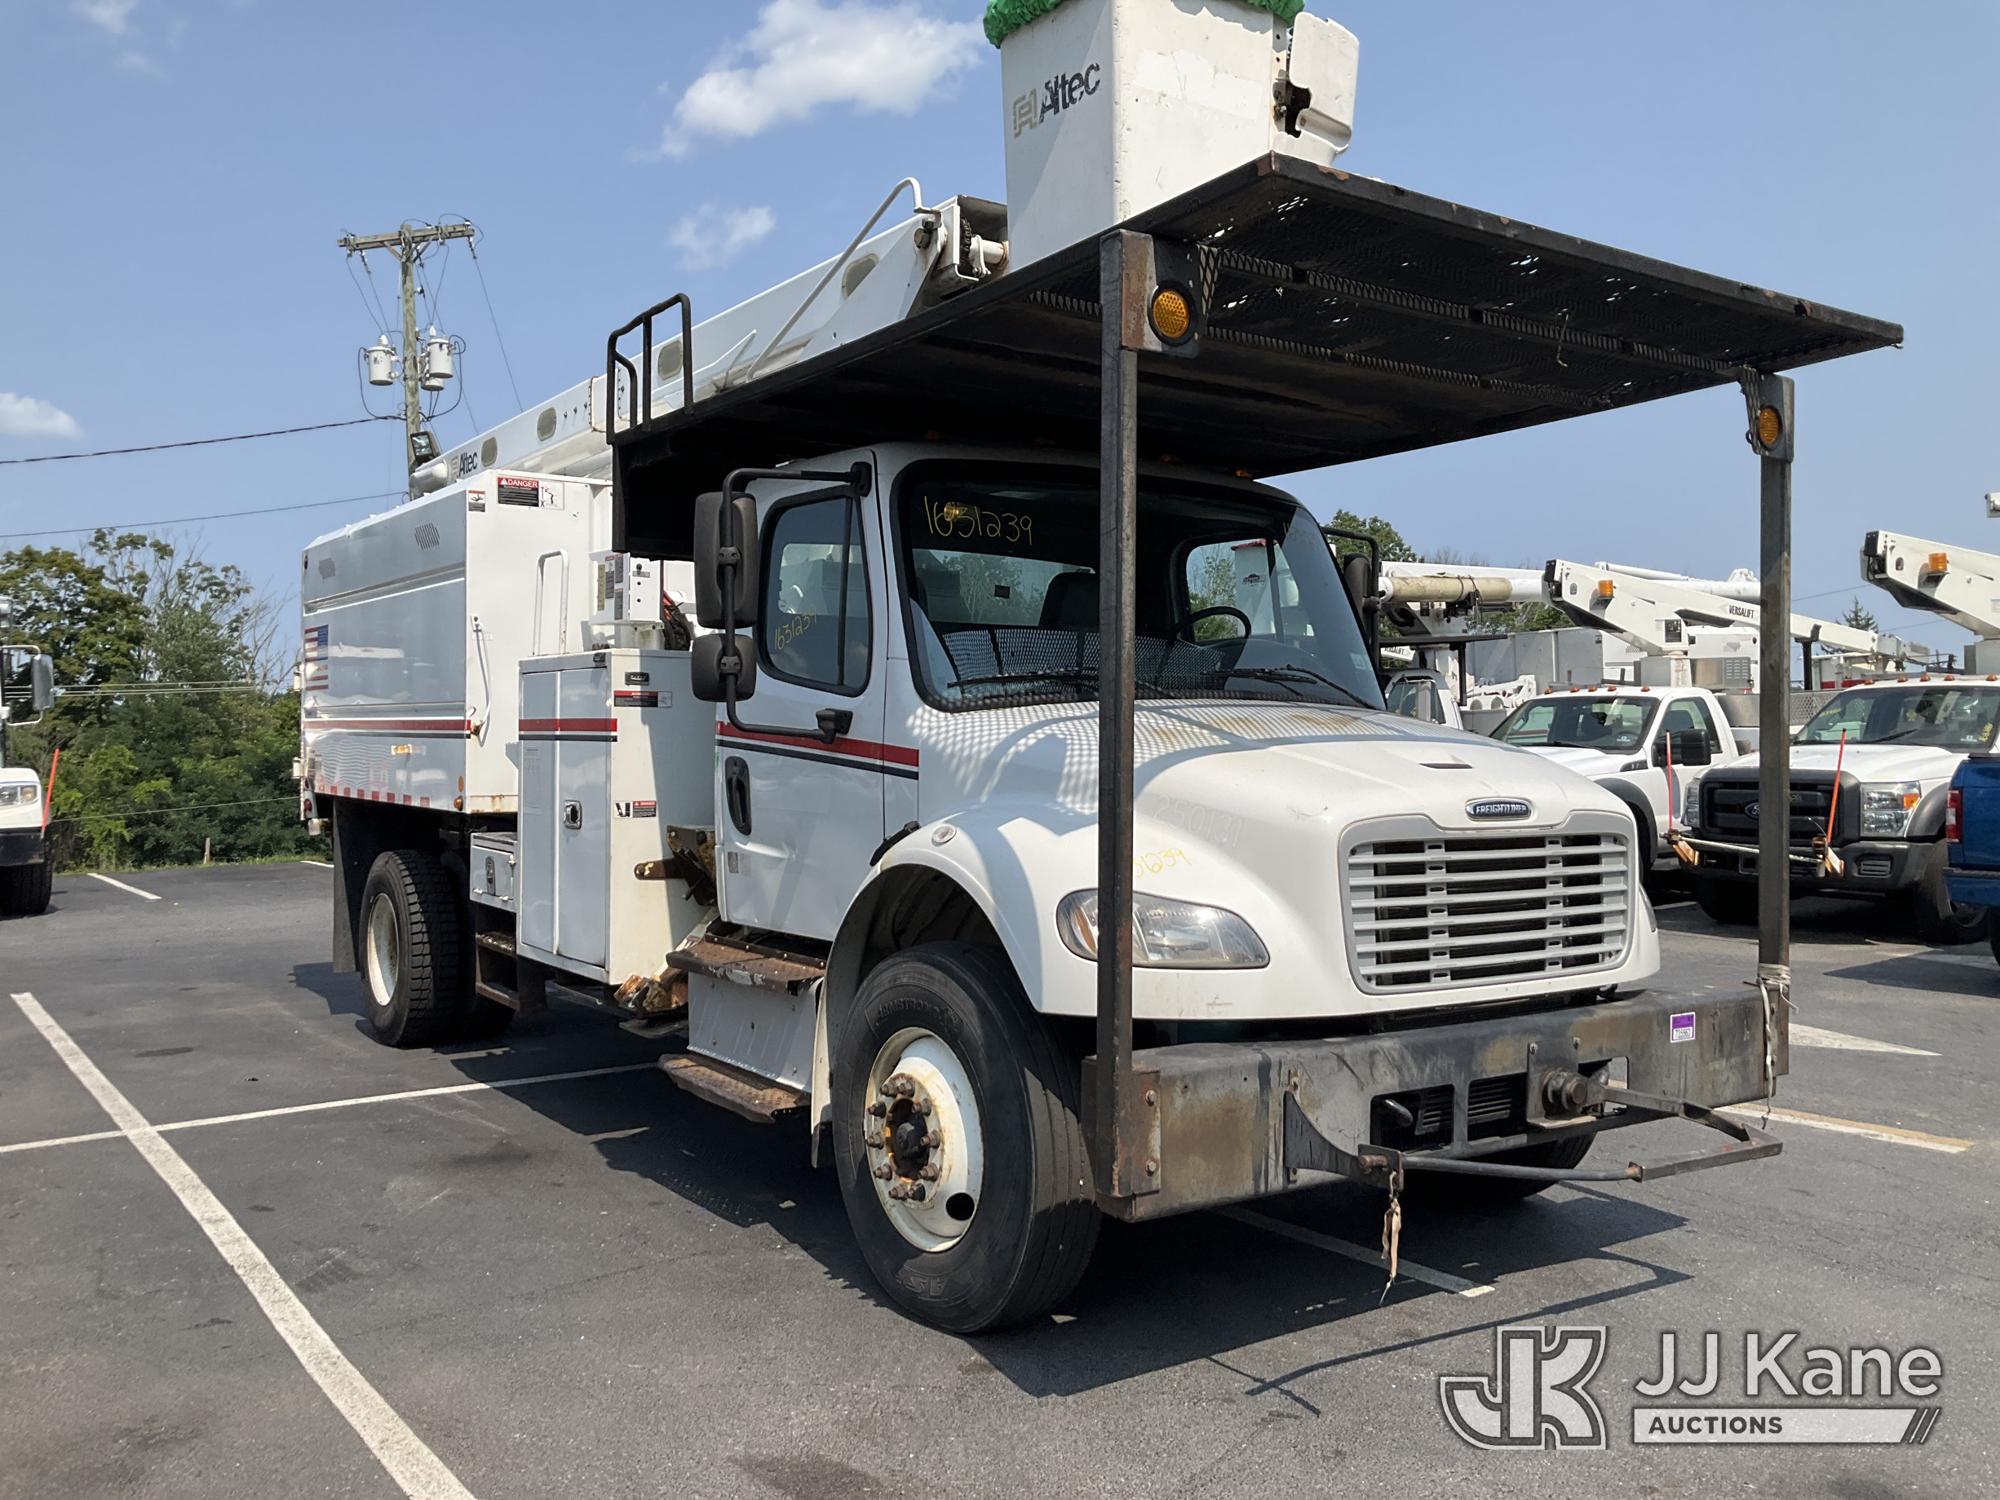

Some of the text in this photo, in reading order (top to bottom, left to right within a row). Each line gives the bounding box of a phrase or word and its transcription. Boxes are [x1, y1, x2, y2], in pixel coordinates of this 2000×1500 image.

[1039, 63, 1101, 124] Altec
[458, 451, 478, 476] Altec
[507, 479, 538, 488] DANGER
[1729, 604, 1755, 619] VERSALIFT
